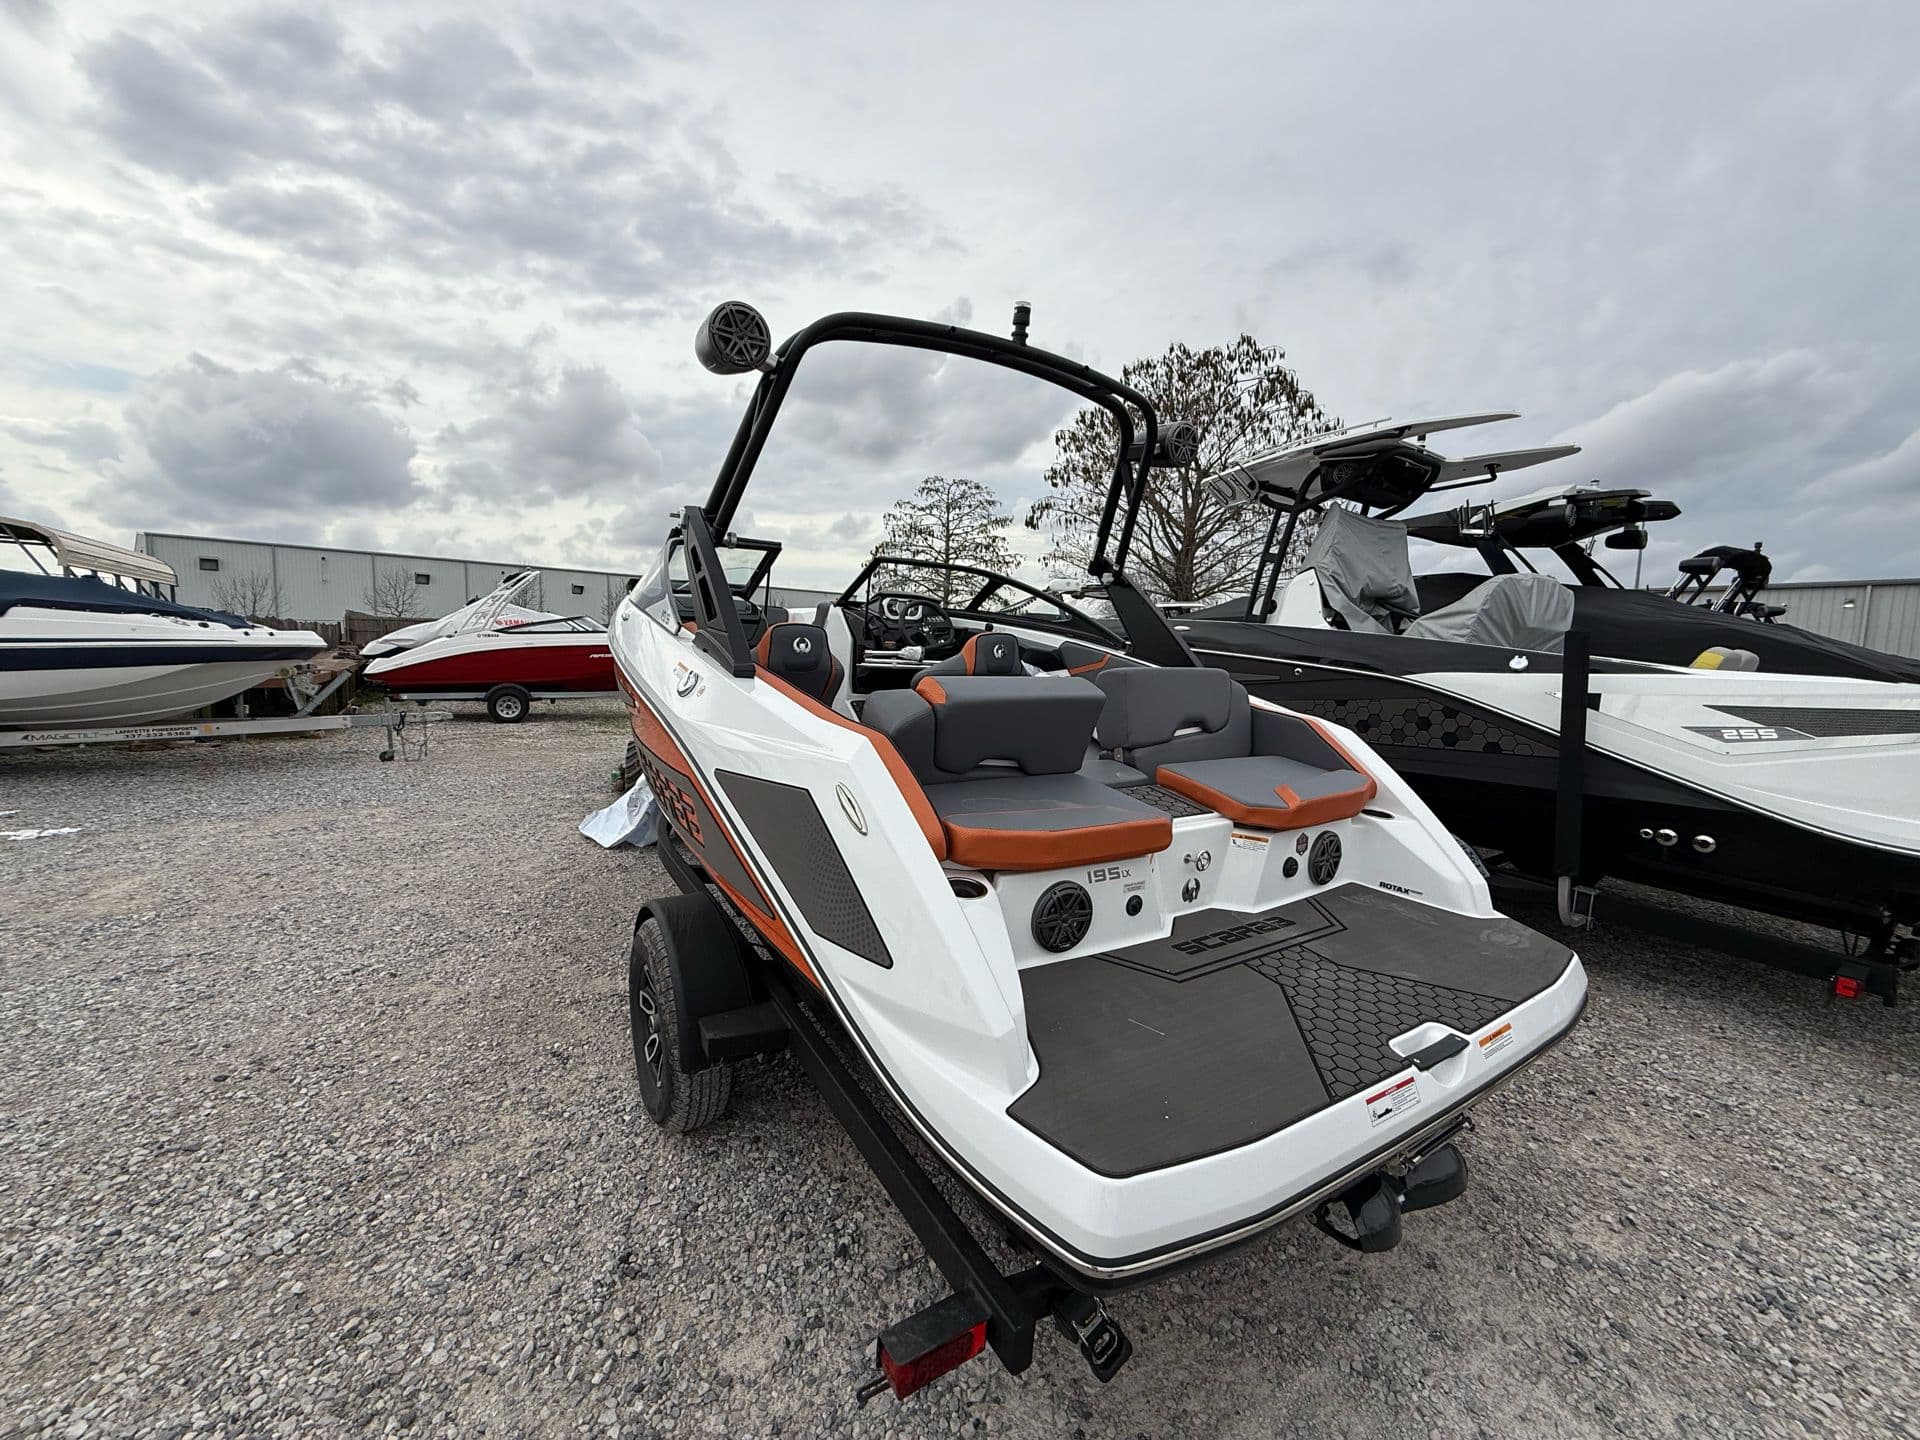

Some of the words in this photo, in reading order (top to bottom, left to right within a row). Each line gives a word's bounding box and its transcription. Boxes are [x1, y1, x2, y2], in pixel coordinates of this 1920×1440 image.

[1721, 728, 1779, 740] 255
[1087, 866, 1120, 884] 195
[1121, 869, 1131, 878] LX
[1379, 881, 1410, 895] ROTAX
